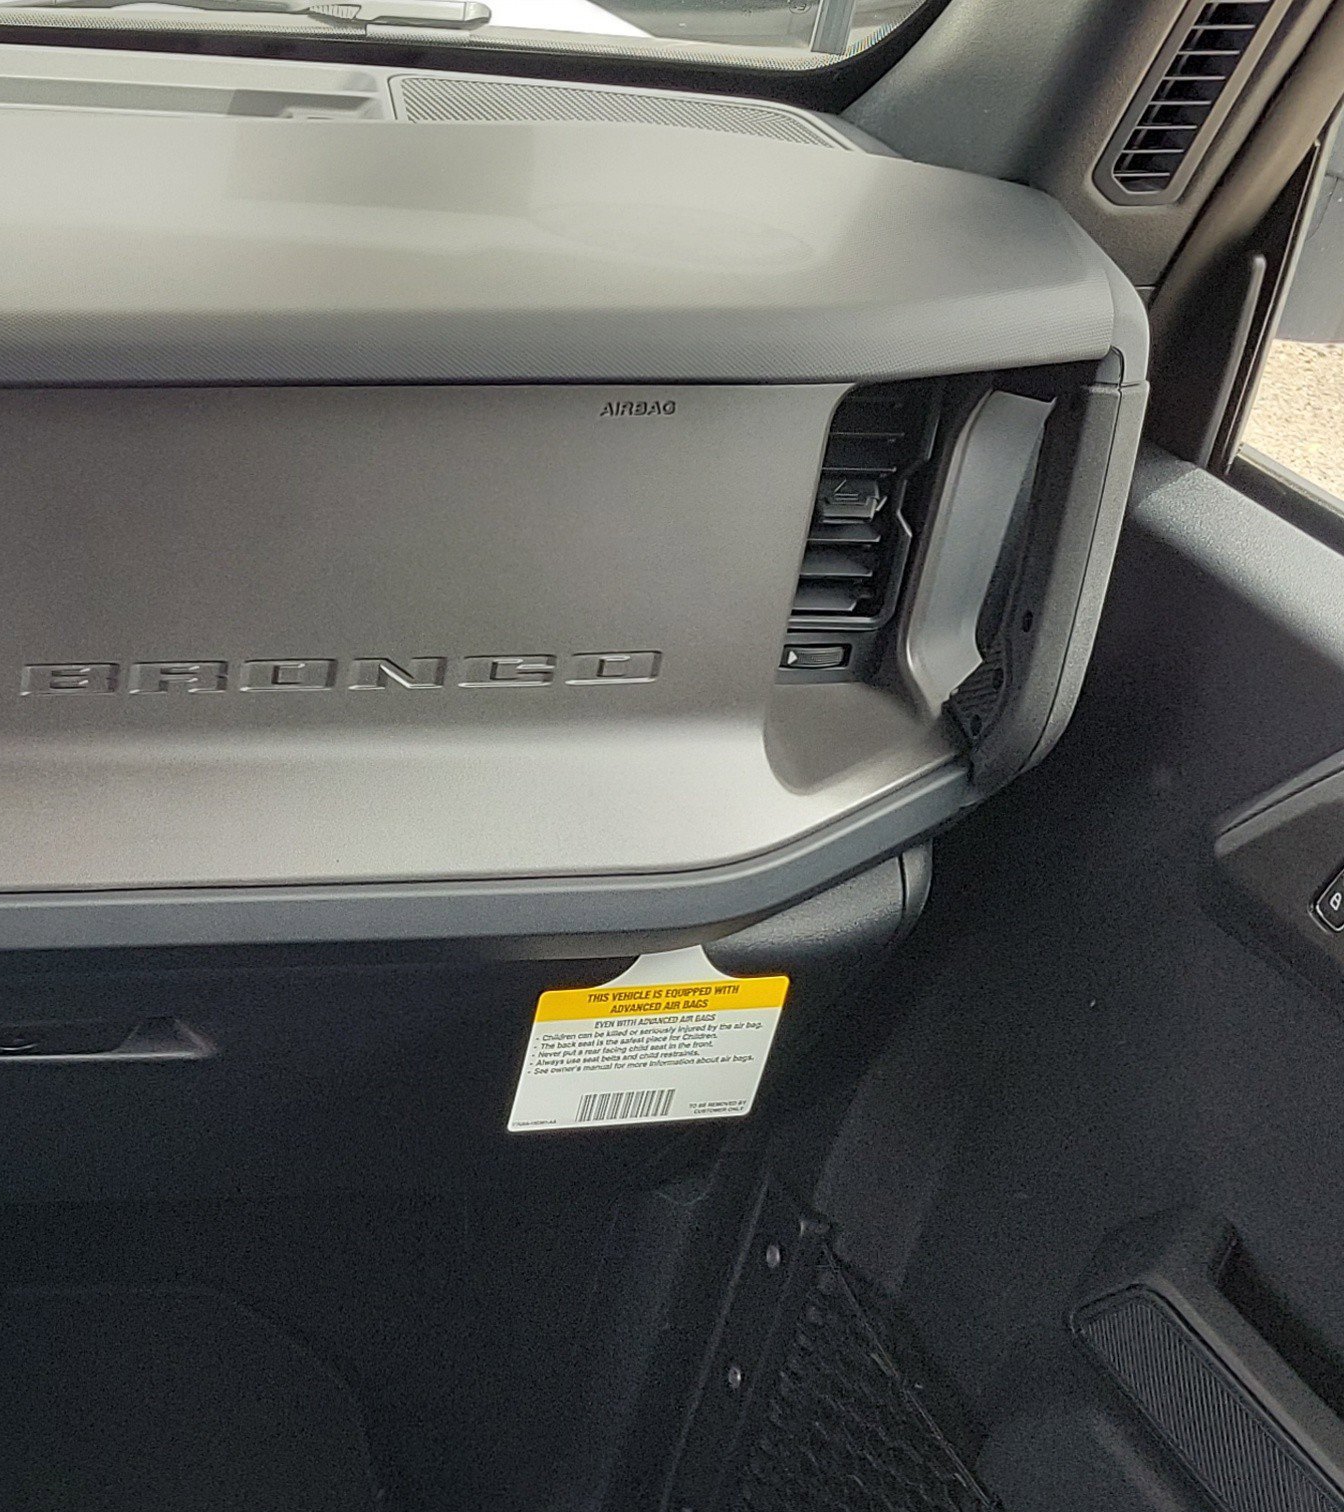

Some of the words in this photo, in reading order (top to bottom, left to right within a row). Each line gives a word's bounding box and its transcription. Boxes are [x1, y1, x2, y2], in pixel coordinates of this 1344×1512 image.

[600, 400, 677, 417] AIRBAG
[19, 650, 664, 697] BRONCO
[588, 993, 609, 1003] THIS
[612, 991, 651, 1000] VEHICLE
[653, 990, 662, 998] IS
[665, 986, 712, 998] EQUIPPED
[714, 985, 740, 995] WITH
[610, 1002, 662, 1013] ADVANCED
[664, 1001, 680, 1010] AIR
[682, 999, 709, 1009] BAGS
[616, 1019, 636, 1027] WITH
[638, 1016, 678, 1025] ADVANCED
